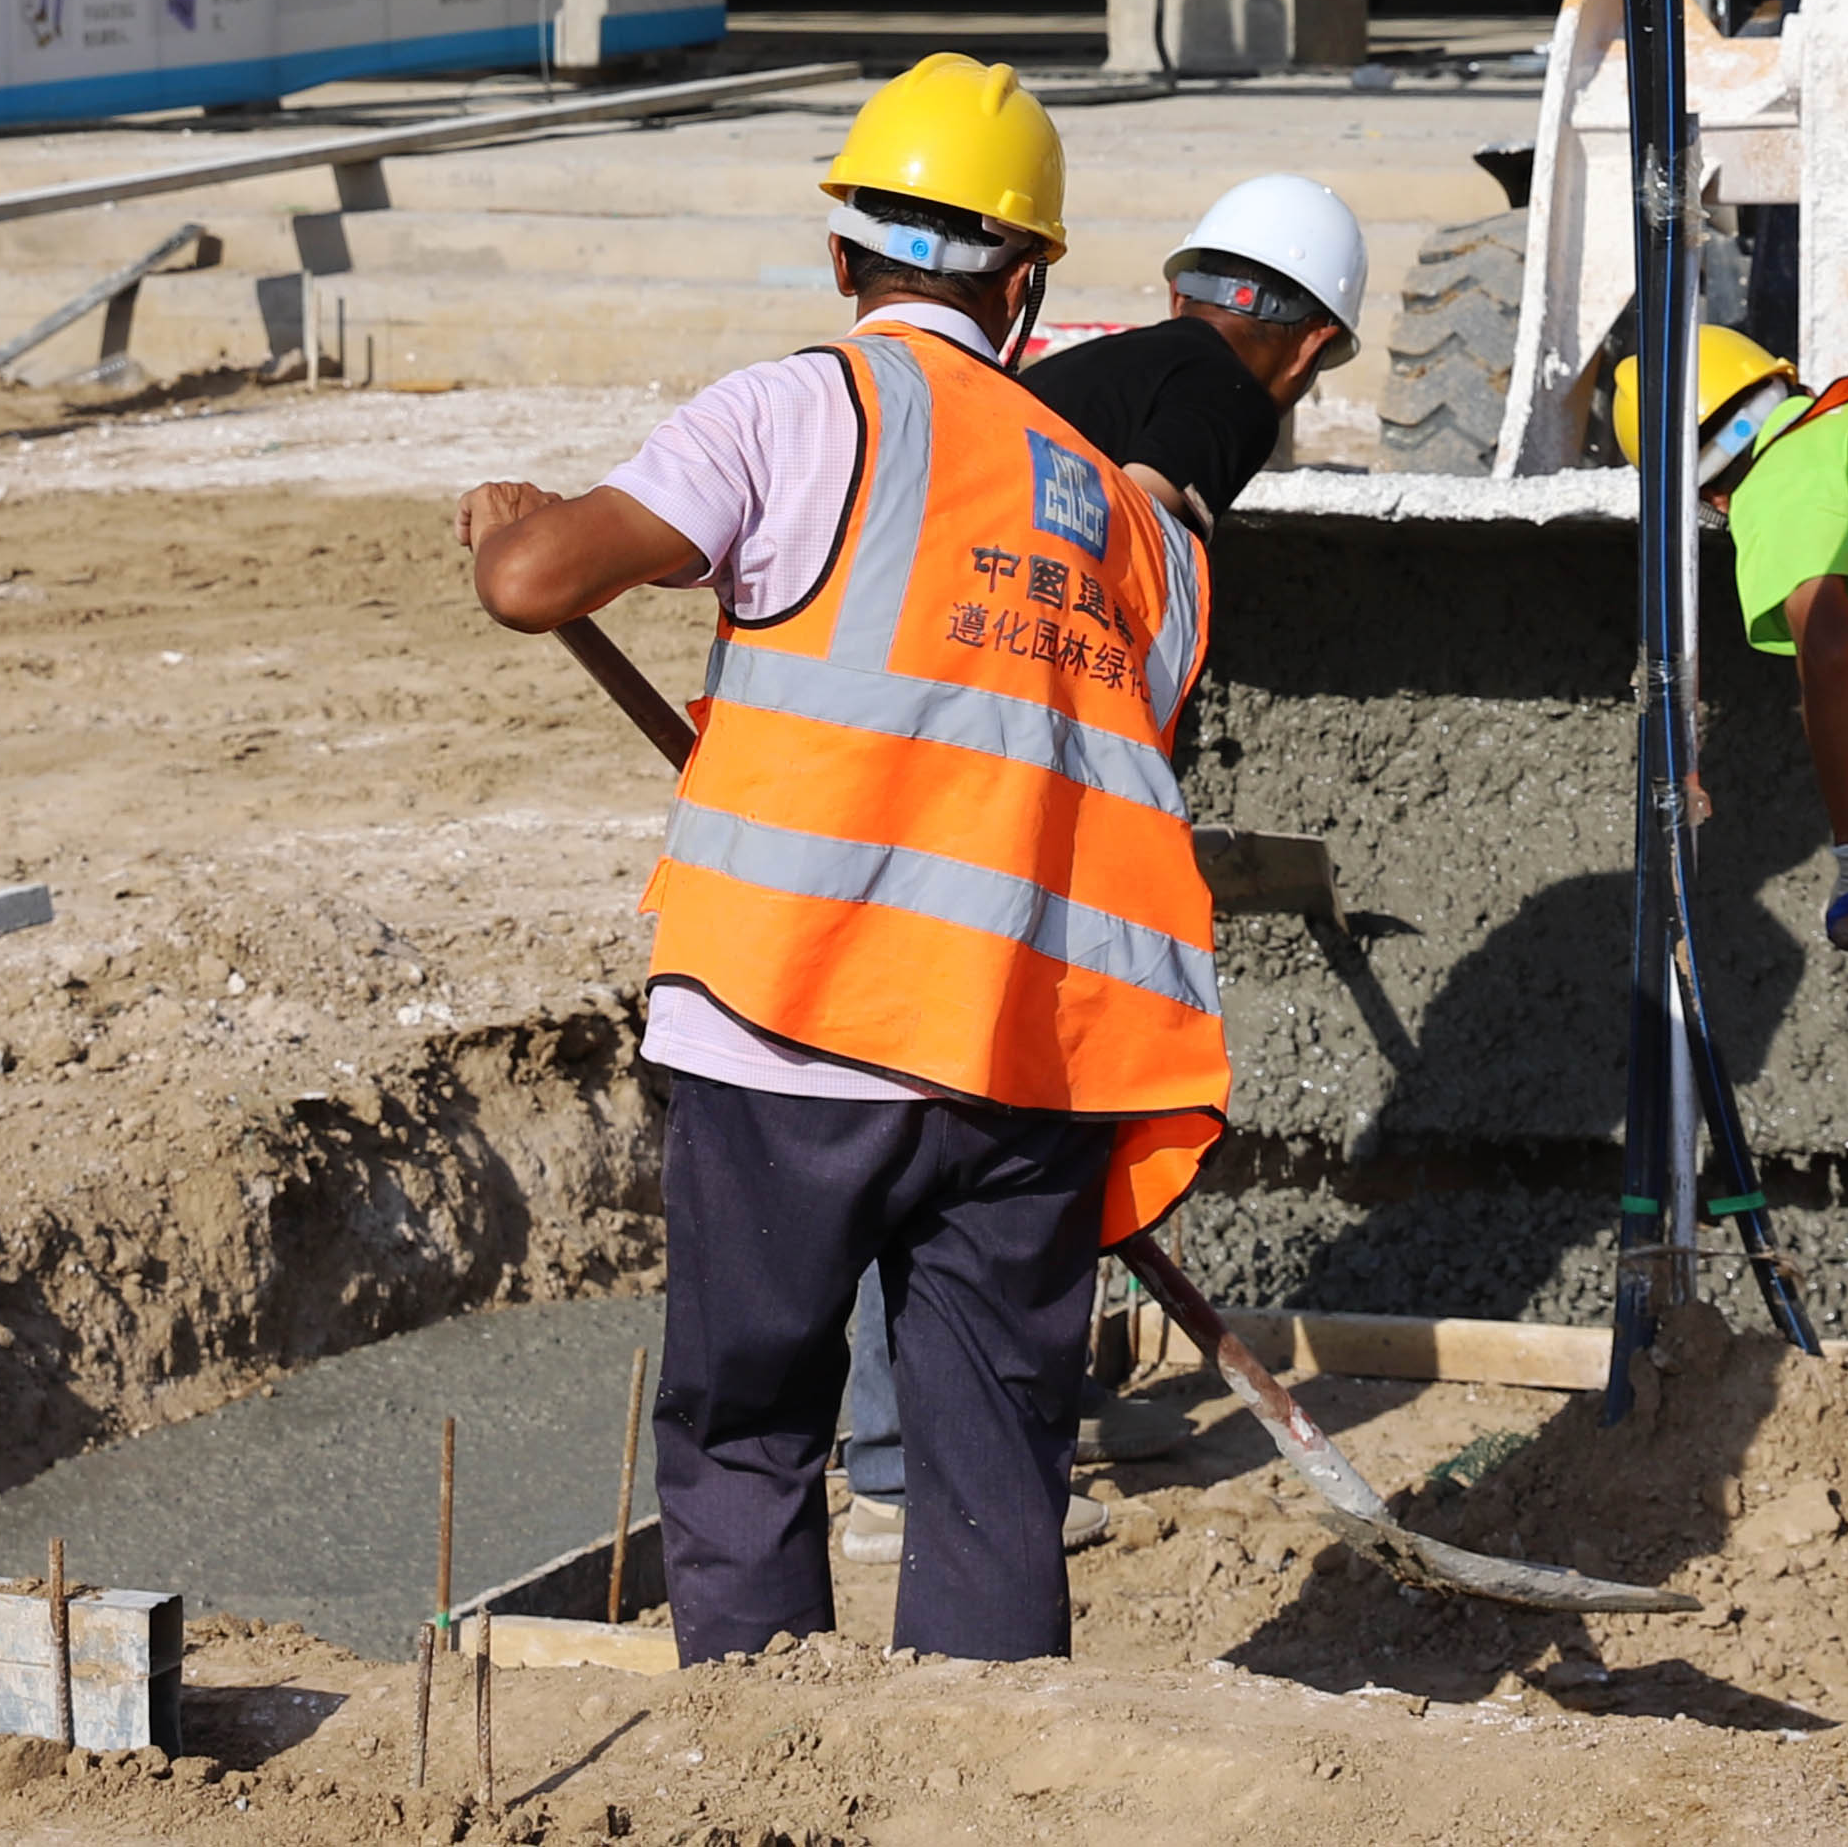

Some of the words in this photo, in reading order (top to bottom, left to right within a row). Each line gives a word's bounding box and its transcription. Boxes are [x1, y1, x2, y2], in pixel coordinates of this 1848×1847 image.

[946, 600, 1151, 704] 遵化园林绿化
